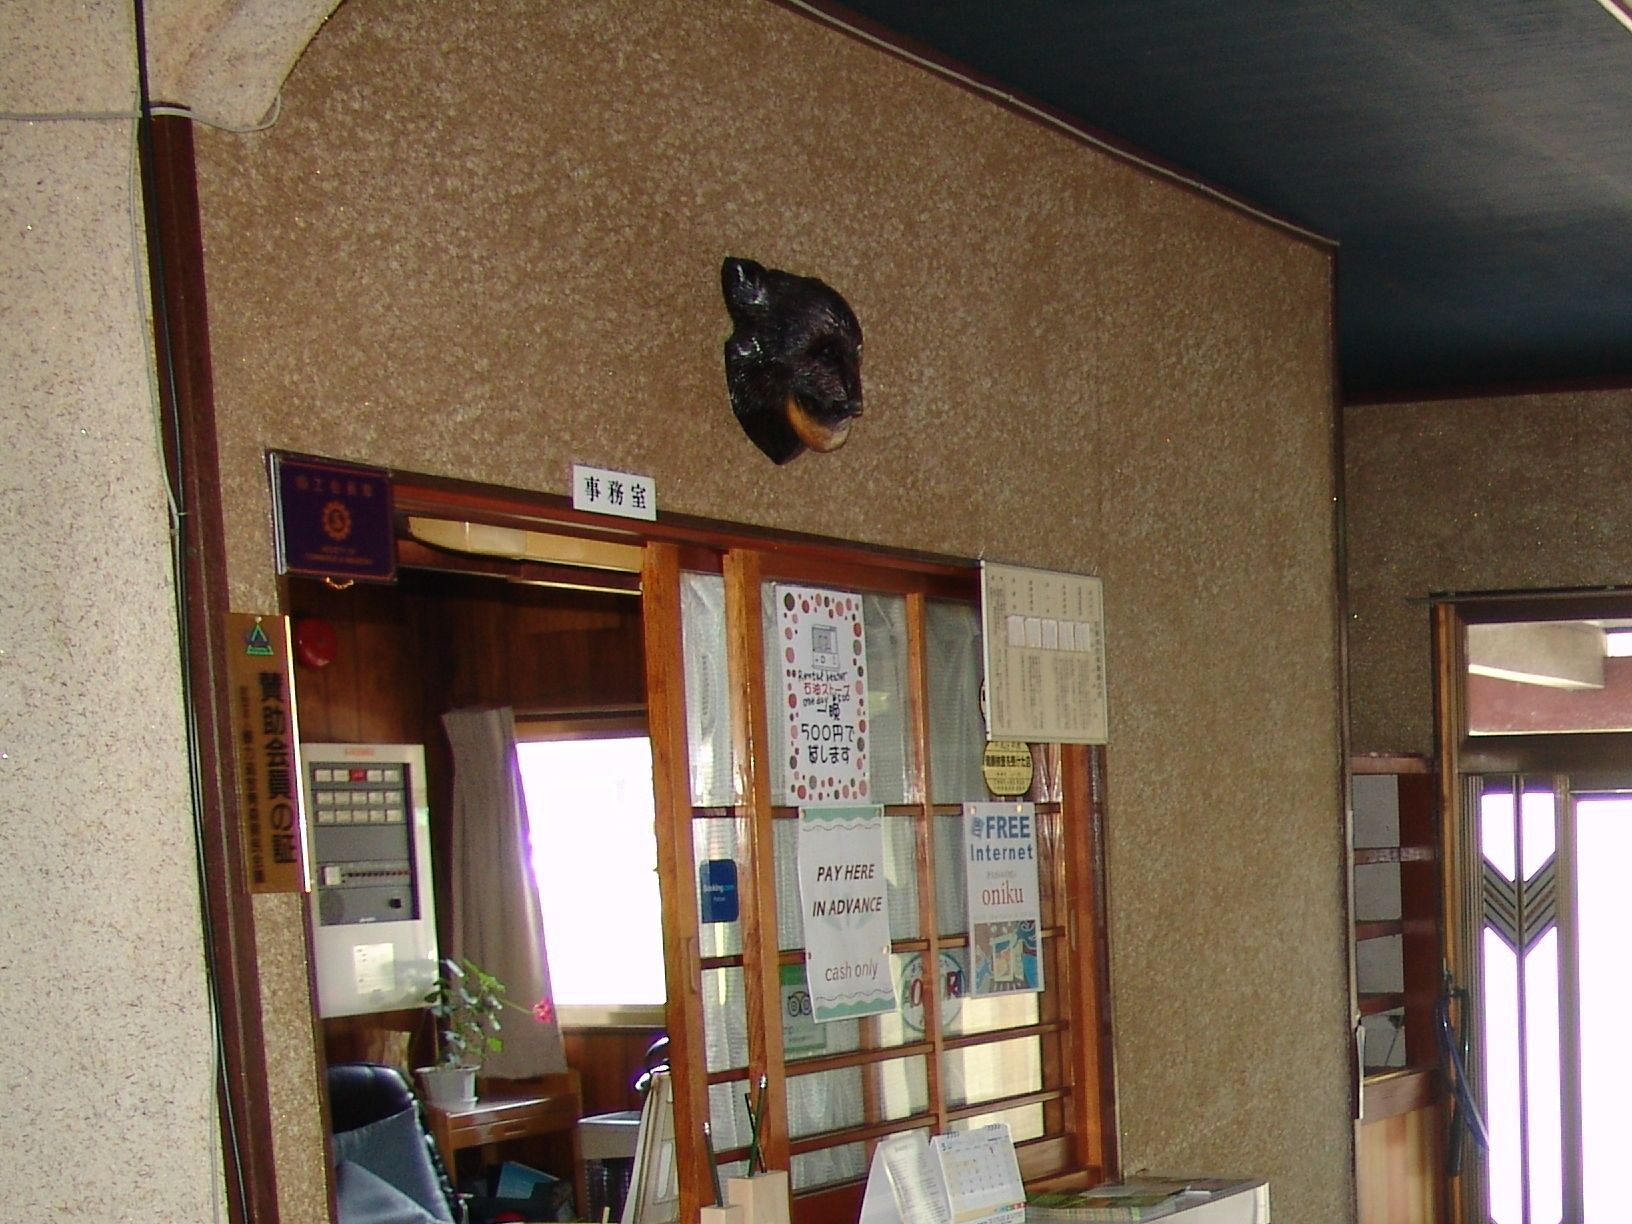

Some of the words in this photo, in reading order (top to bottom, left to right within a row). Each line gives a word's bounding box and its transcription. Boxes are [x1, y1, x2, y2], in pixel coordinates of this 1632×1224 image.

[584, 475, 646, 509] 事務室
[801, 723, 855, 742] 500円で
[986, 815, 1031, 839] FREE
[970, 843, 1033, 862] Internet
[817, 865, 842, 882] PAY
[844, 863, 876, 880] HERE
[982, 879, 1024, 906] oniku
[812, 900, 826, 917] IN
[829, 896, 883, 916] ADVANCE
[825, 960, 852, 982] cash
[855, 957, 879, 981] only
